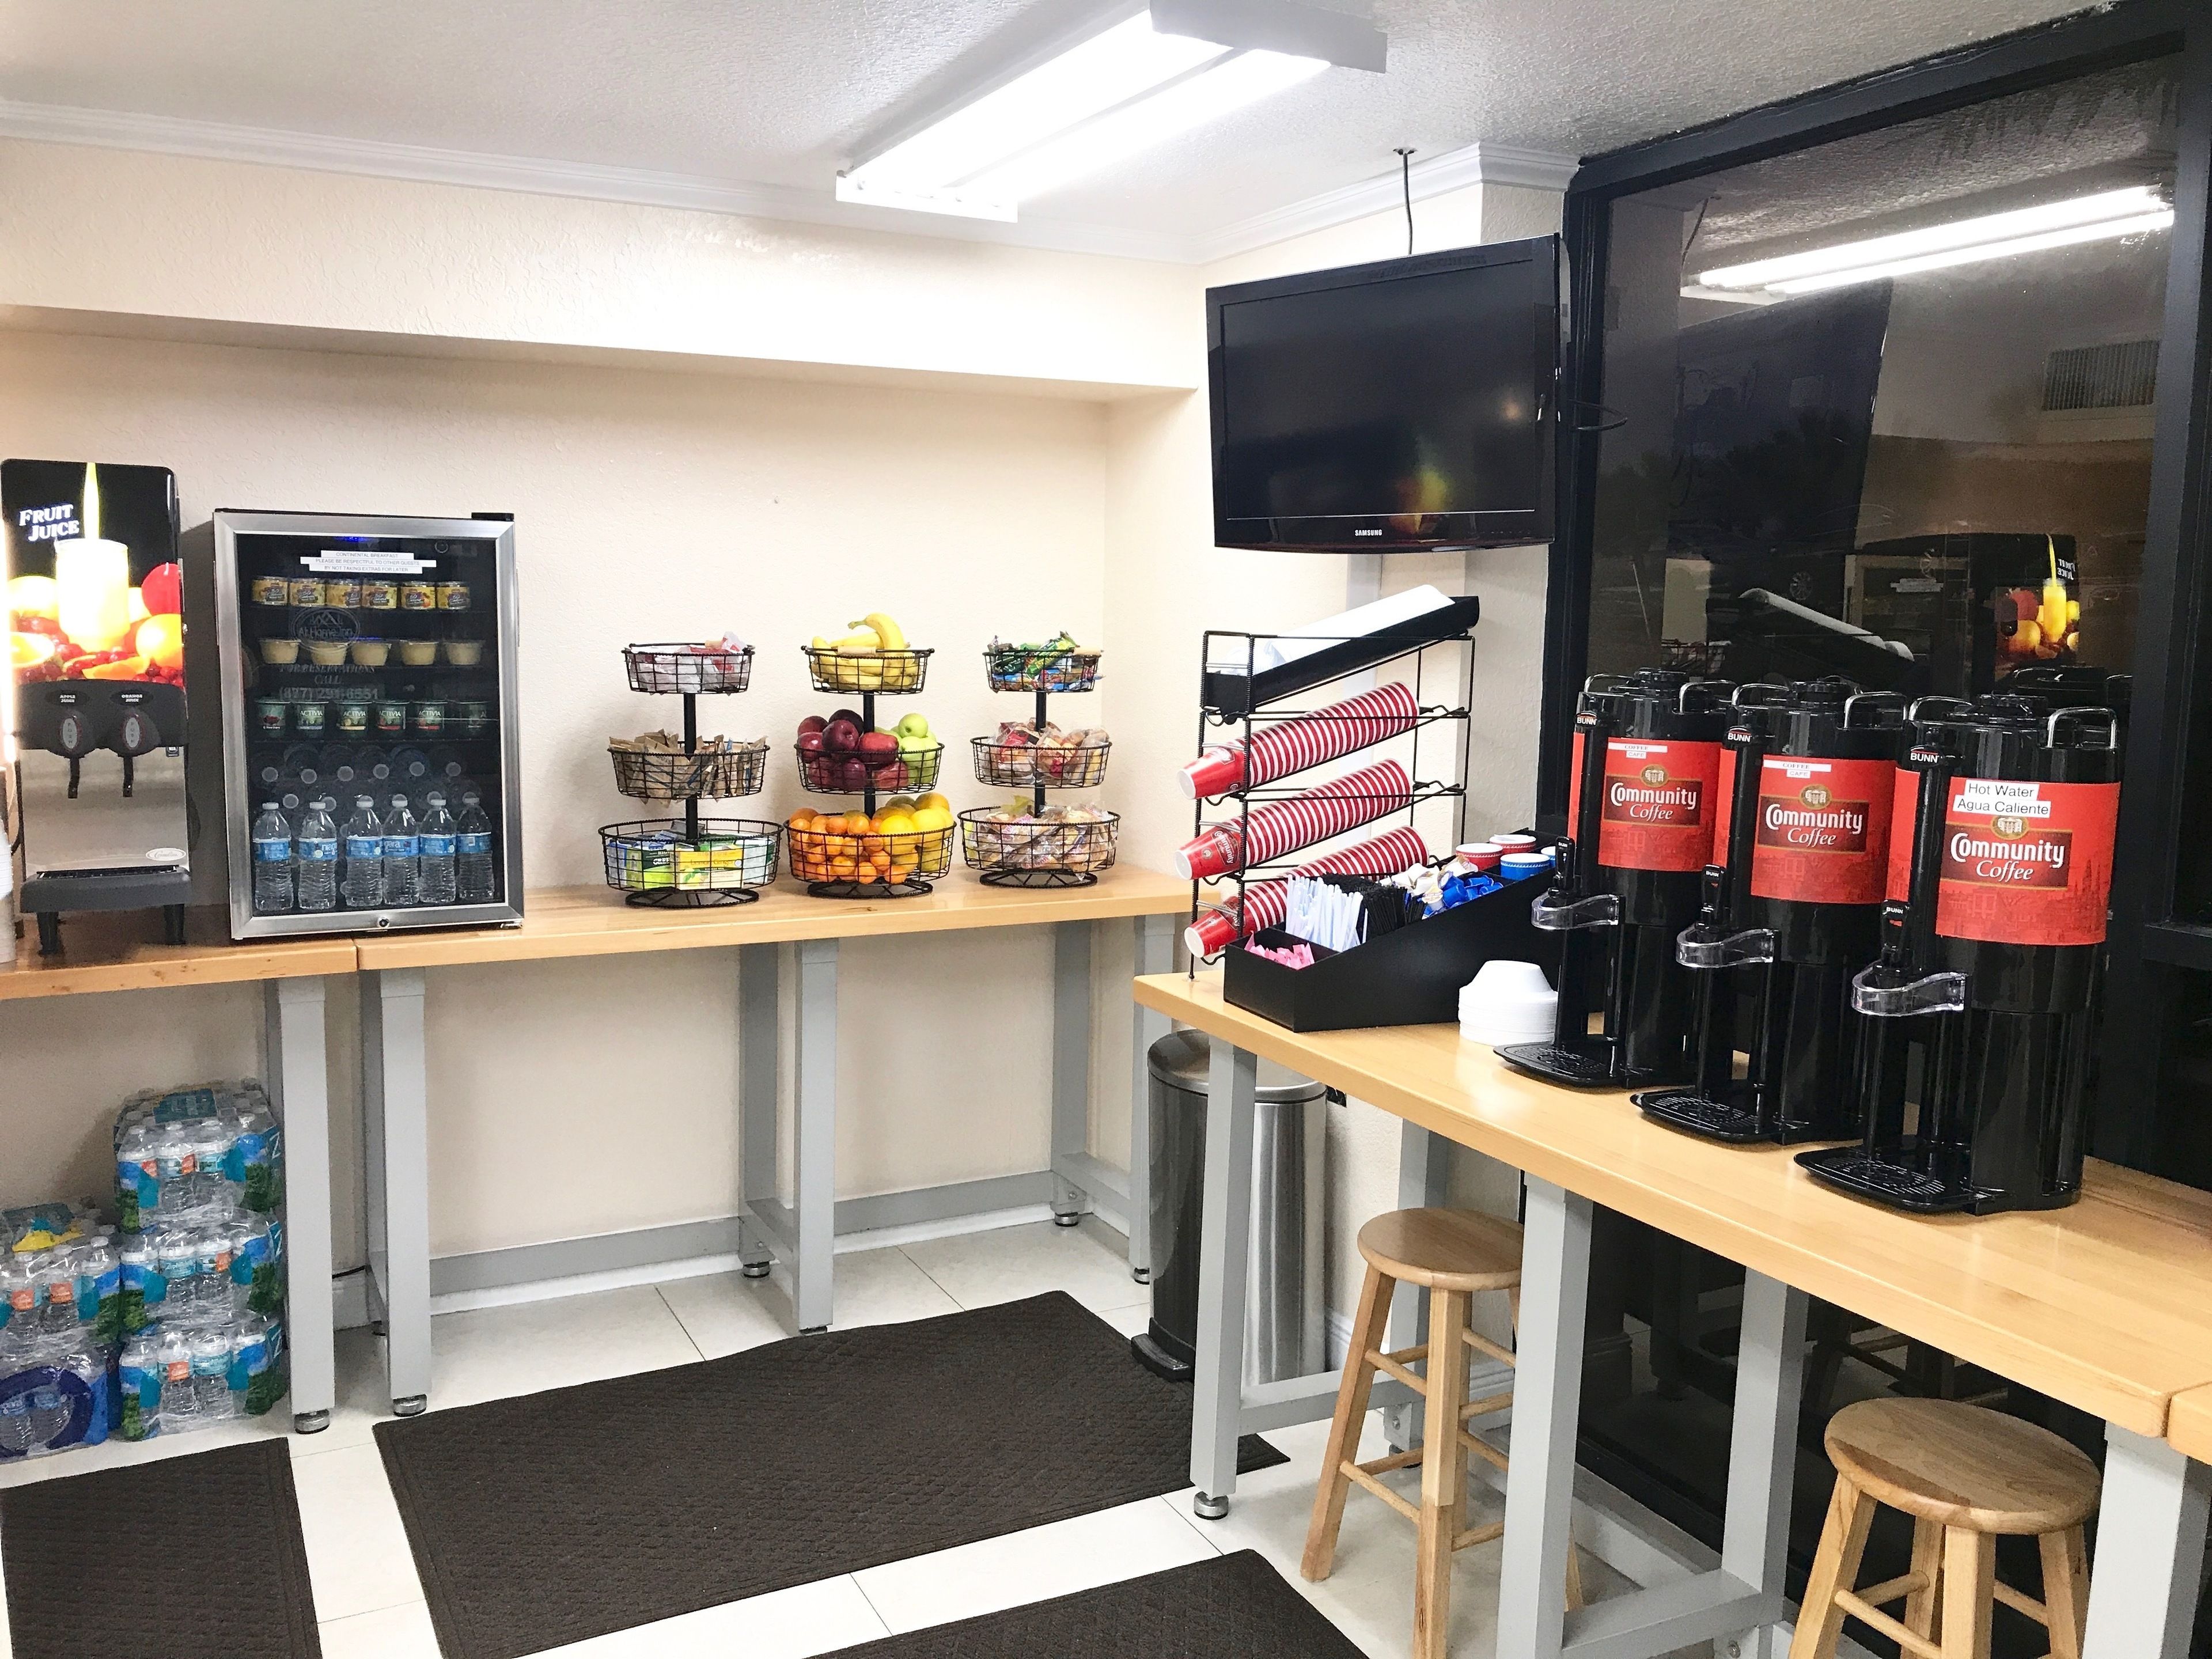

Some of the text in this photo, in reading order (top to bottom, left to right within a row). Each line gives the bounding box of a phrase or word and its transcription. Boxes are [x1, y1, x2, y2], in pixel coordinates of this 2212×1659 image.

[18, 504, 74, 527] FRUIT
[28, 520, 79, 541] JUICE
[1577, 717, 1596, 725] BUNN
[1728, 733, 1751, 743] BUNN
[1910, 752, 1938, 763] BUNN
[1611, 782, 1696, 810] Community
[1968, 783, 2034, 797] Hot Water
[1630, 804, 1673, 823] Coffee
[1957, 798, 2049, 815] Agua Caliente
[1766, 804, 1863, 835] Community
[1787, 828, 1836, 847] Coffee
[1950, 832, 2065, 869] Community
[1976, 860, 2034, 882] Coffee
[1886, 906, 1903, 914] BUNN
